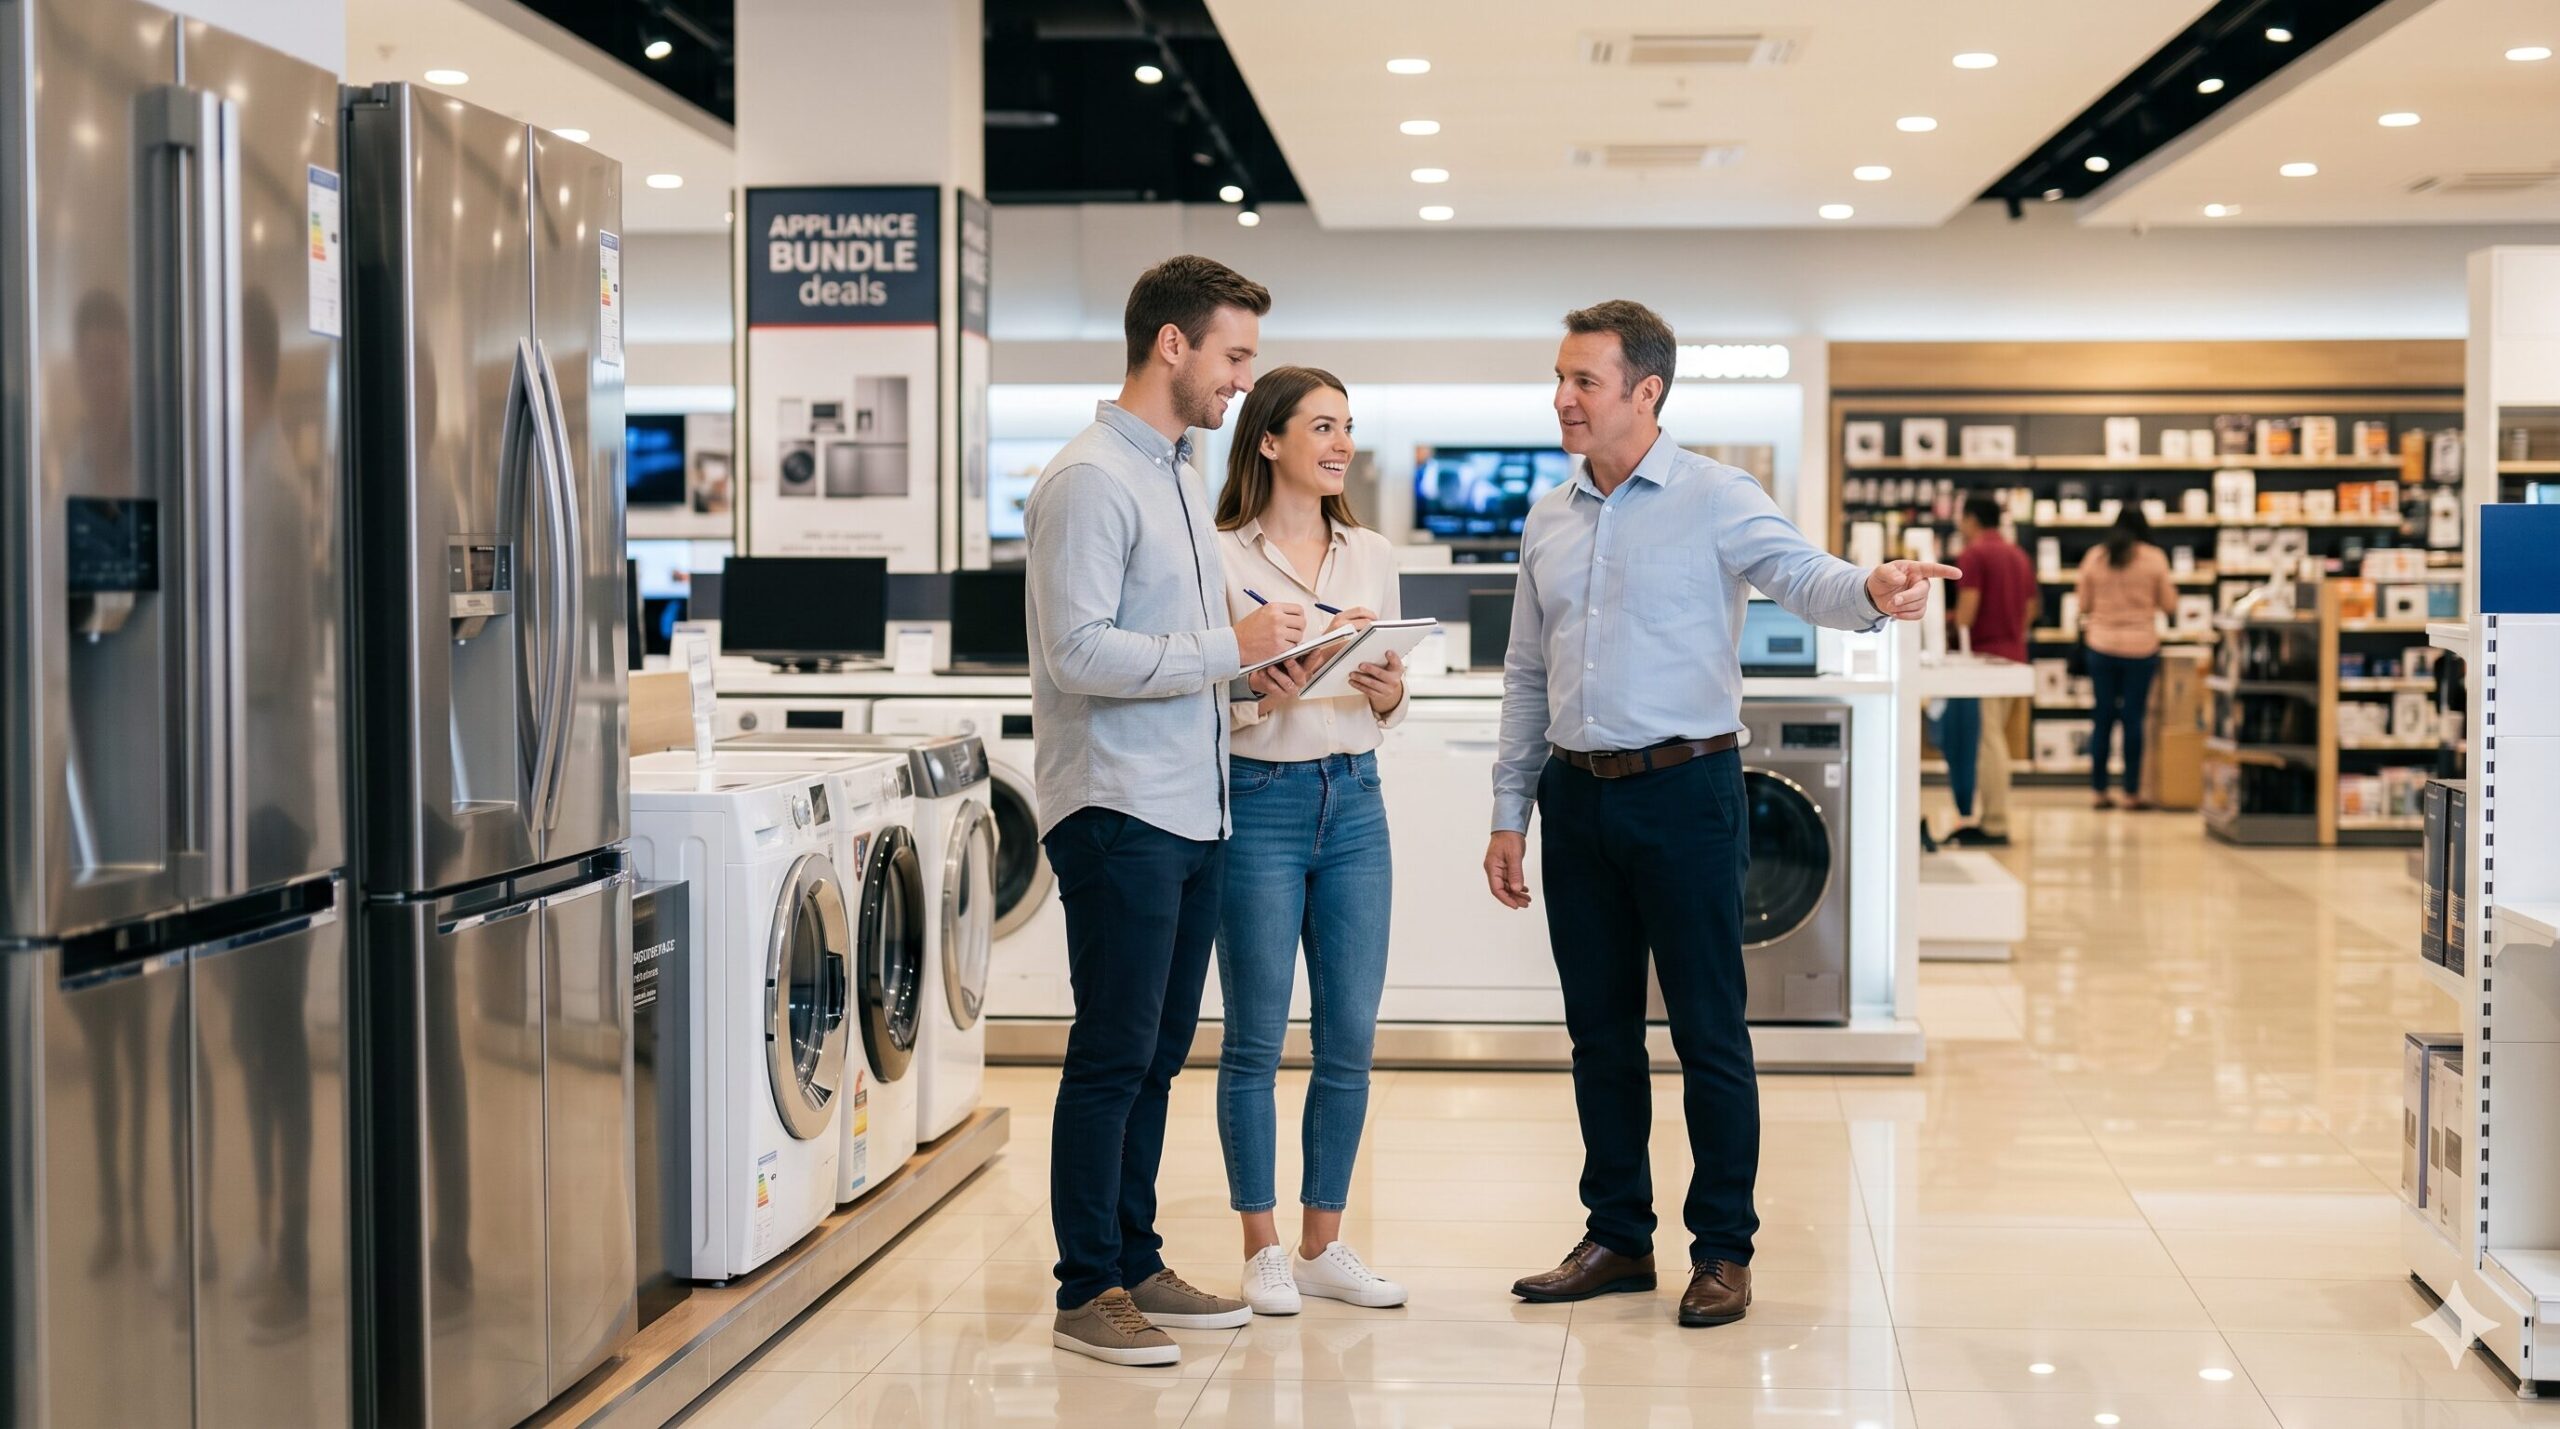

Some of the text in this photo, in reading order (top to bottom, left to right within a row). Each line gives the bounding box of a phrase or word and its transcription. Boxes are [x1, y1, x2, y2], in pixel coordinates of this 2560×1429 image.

[769, 213, 918, 239] APPLIANCE
[769, 240, 918, 273] BUNDLE
[799, 273, 888, 307] deals
